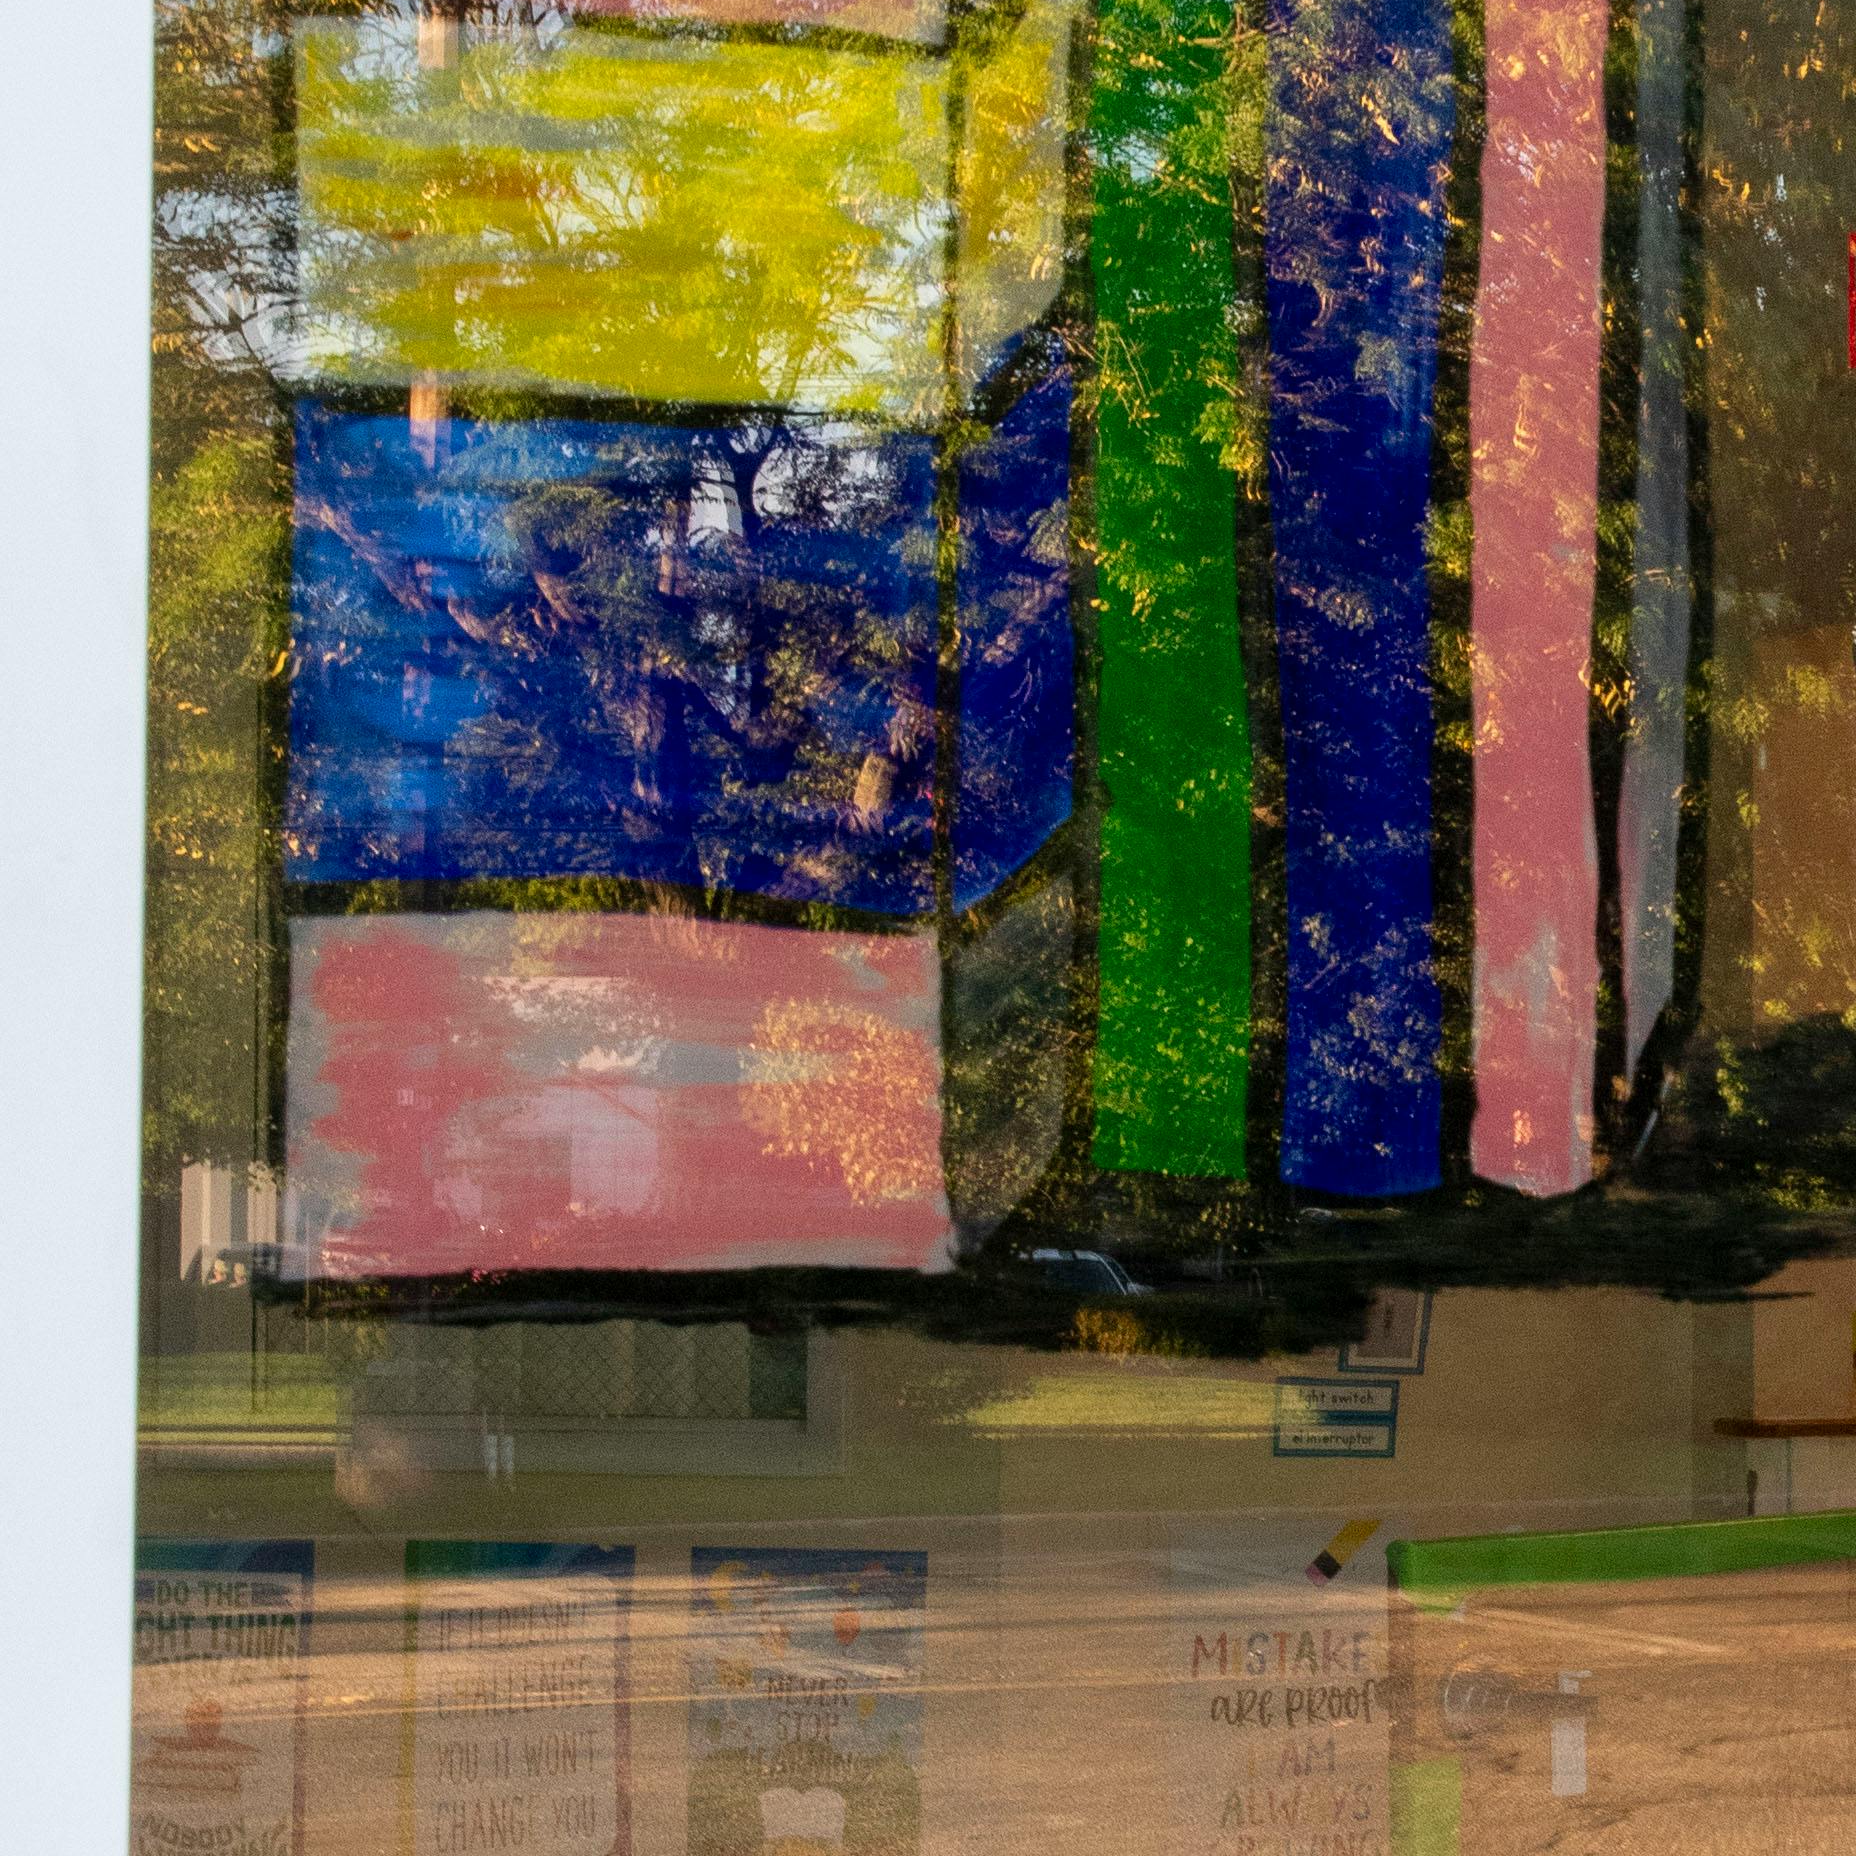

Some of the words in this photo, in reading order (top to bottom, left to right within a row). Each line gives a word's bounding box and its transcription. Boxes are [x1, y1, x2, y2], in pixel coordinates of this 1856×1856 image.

[1331, 1389, 1374, 1405] switch
[156, 1580, 190, 1606] DO
[199, 1581, 248, 1607] THE
[767, 1673, 848, 1706] NEVER
[776, 1709, 841, 1743] STOP
[492, 1736, 512, 1779] IT
[523, 1728, 598, 1777] WON'T
[1276, 1737, 1336, 1778] AM
[140, 1812, 246, 1849] NOBODY
[434, 1795, 535, 1854] CHANGE
[552, 1795, 597, 1838] YOU
